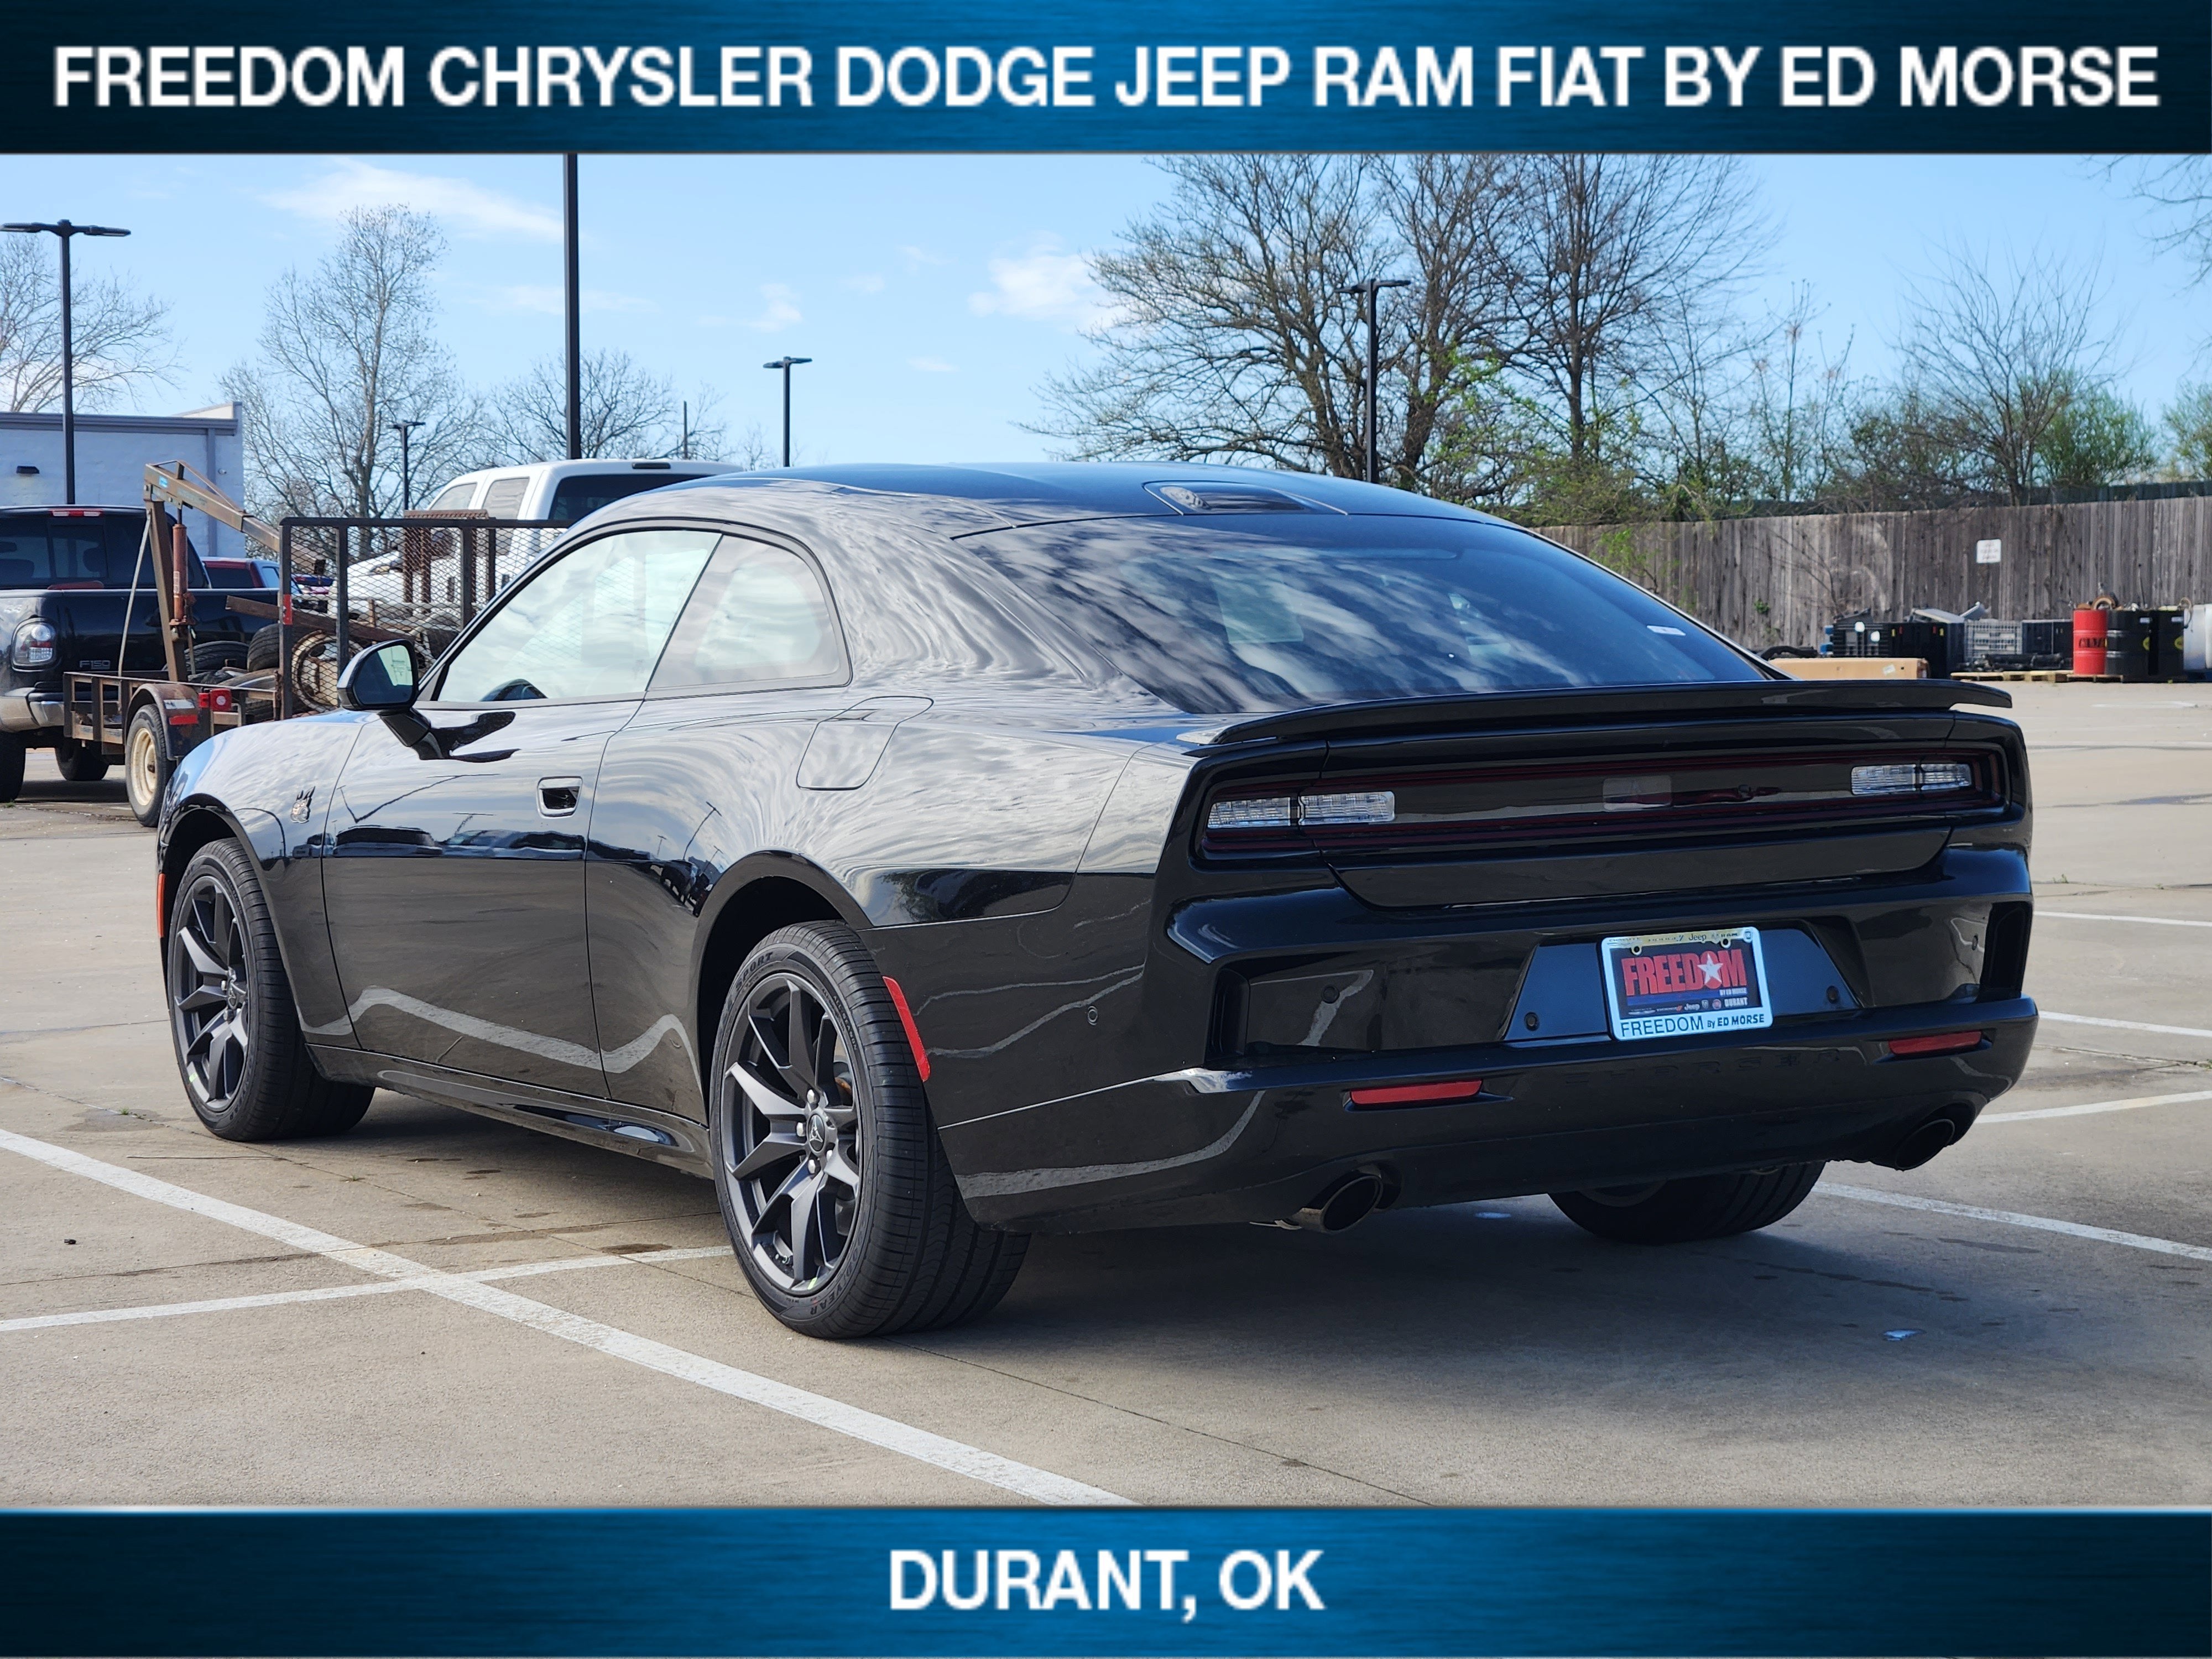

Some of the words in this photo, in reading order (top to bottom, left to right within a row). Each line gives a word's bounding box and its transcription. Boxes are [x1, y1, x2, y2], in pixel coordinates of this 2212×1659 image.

[1688, 933, 1707, 941] Jeep
[735, 951, 774, 992] SPORT
[1621, 948, 1747, 997] FREEDOM
[1724, 997, 1747, 1008] DURANT
[1620, 1015, 1704, 1037] FREEDOM
[1717, 1017, 1729, 1027] ED
[1731, 1014, 1765, 1026] MORSE
